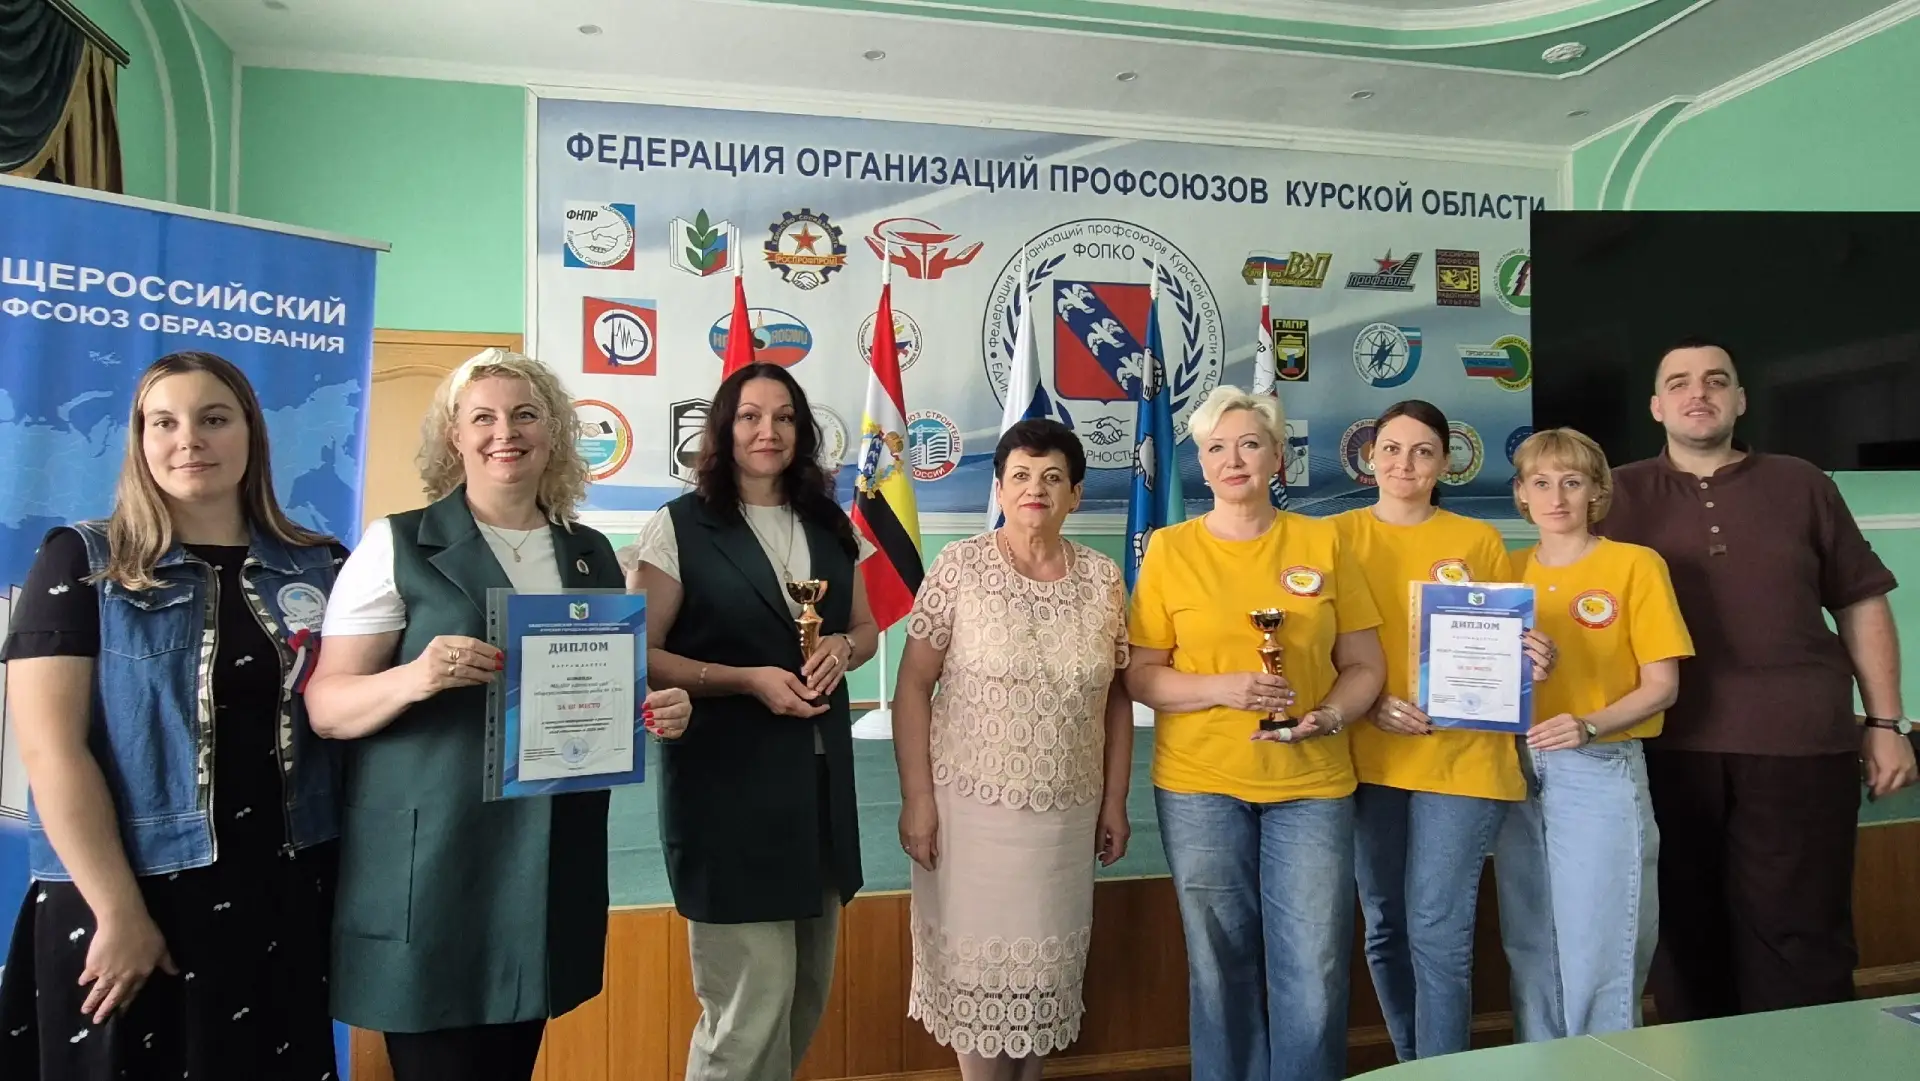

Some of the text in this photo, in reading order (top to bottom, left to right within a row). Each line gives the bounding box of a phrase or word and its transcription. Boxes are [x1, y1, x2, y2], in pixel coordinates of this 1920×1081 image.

[566, 132, 1546, 220] ФЕДЕРАЦИЯ ОРГАНИЗАЦИЙ ПРОФСОЮЗОВ КУРСКОЙ ОБЛАСТИ
[566, 209, 599, 222] ФНПР
[1072, 242, 1135, 260] ФОПКО
[2, 256, 346, 327] ЩЕРОССИЙСКИЙ
[988, 223, 1218, 353] федерация оганизаций профсоюзов Курской области
[0, 297, 345, 354] ФСОЮЗ ОБРАЗОВАНИЯ
[1275, 320, 1307, 329] ГМПР
[908, 411, 921, 423] ЮЗ
[1086, 449, 1134, 462] РНОСТЬ
[1450, 620, 1500, 631] ДИПЛОМ
[548, 641, 609, 655] ДИПЛОМ
